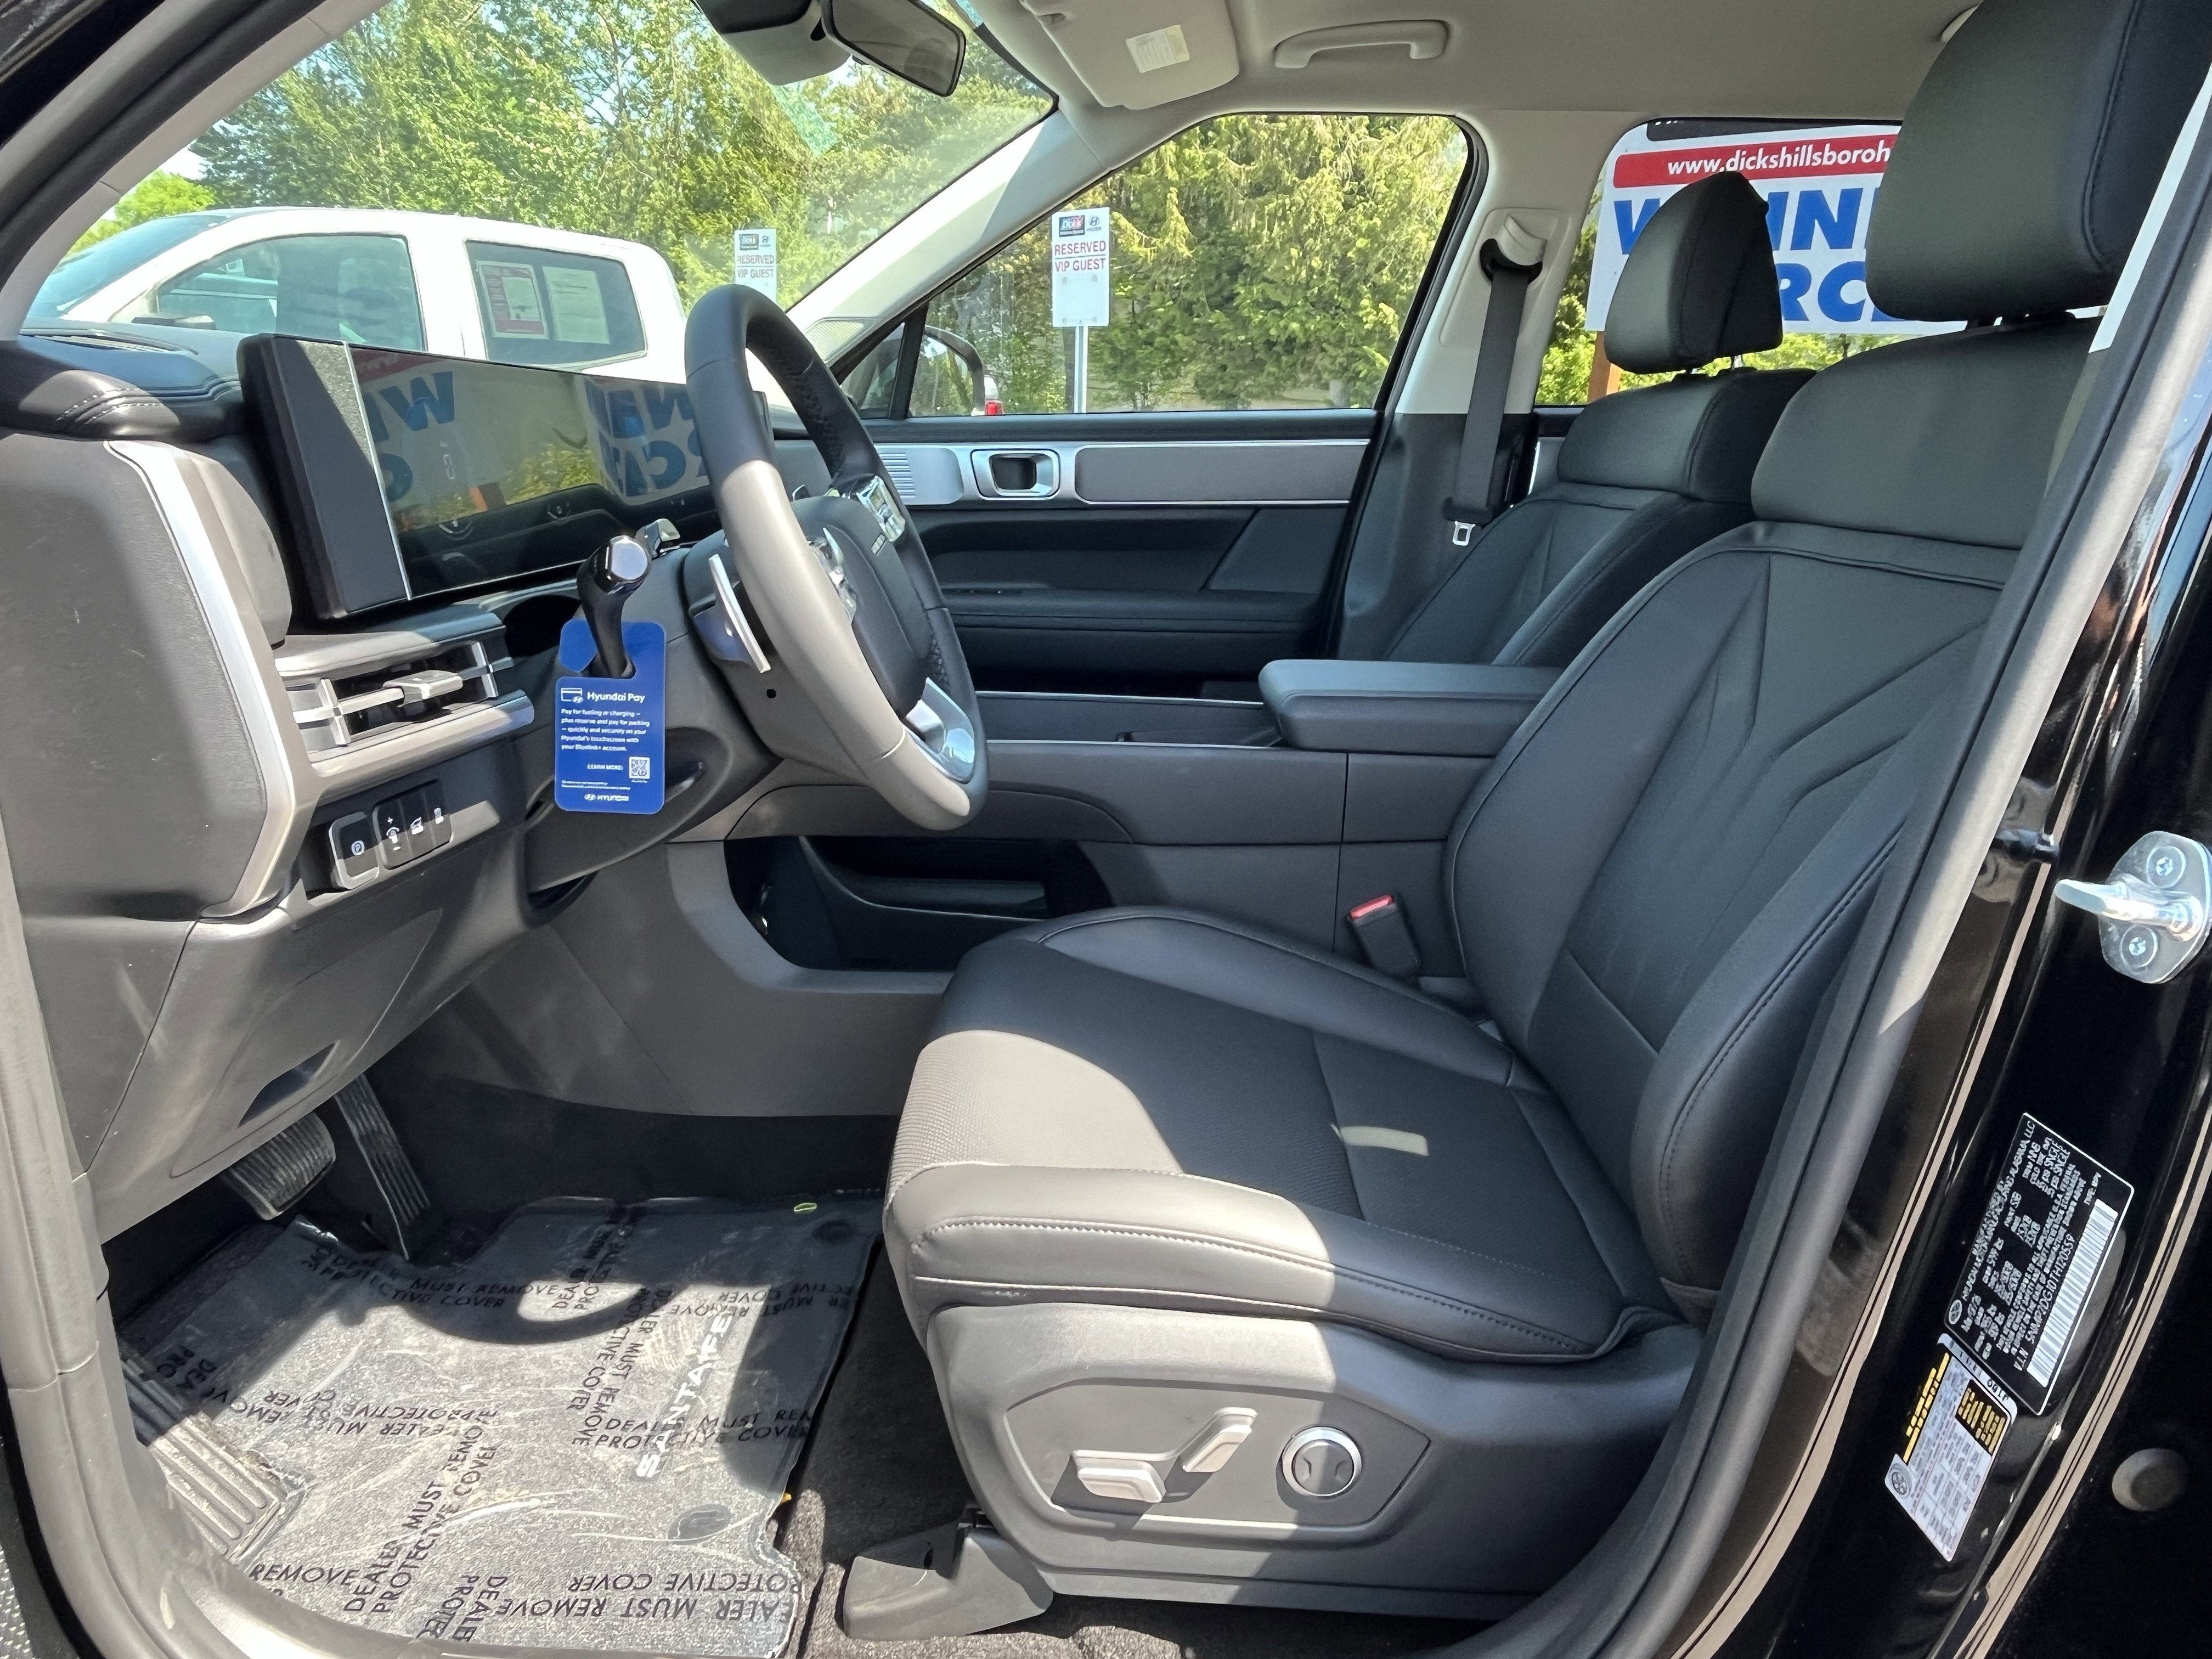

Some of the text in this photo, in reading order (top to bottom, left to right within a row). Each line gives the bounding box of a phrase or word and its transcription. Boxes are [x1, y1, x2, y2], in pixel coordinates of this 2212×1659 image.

[1054, 240, 1106, 256] RESERVED
[737, 255, 775, 264] RESERVED
[1055, 258, 1106, 272] VIP GUEST
[737, 269, 774, 278] VIP GUEST
[587, 692, 645, 703] Hyundai Pay
[2024, 1121, 2035, 1139] LLC
[410, 1278, 560, 1296] MUST REMOVE
[718, 1289, 781, 1303] COVER
[441, 1295, 505, 1308] COVER
[671, 1304, 749, 1318] REMOVE
[612, 1342, 644, 1379] MUST
[565, 1366, 606, 1410] COVER
[636, 1314, 733, 1478] SANTA FE
[263, 1389, 472, 1421] PROTECTIVE COVER
[302, 1406, 366, 1435] MUST
[572, 1387, 620, 1446] REMOVE
[699, 1411, 761, 1432] MUST
[403, 1481, 443, 1529] MUST
[249, 1564, 359, 1587] REMOVE
[568, 1573, 653, 1591] COVER
[495, 1598, 609, 1619] REMOVE
[620, 1598, 698, 1619] MUST
